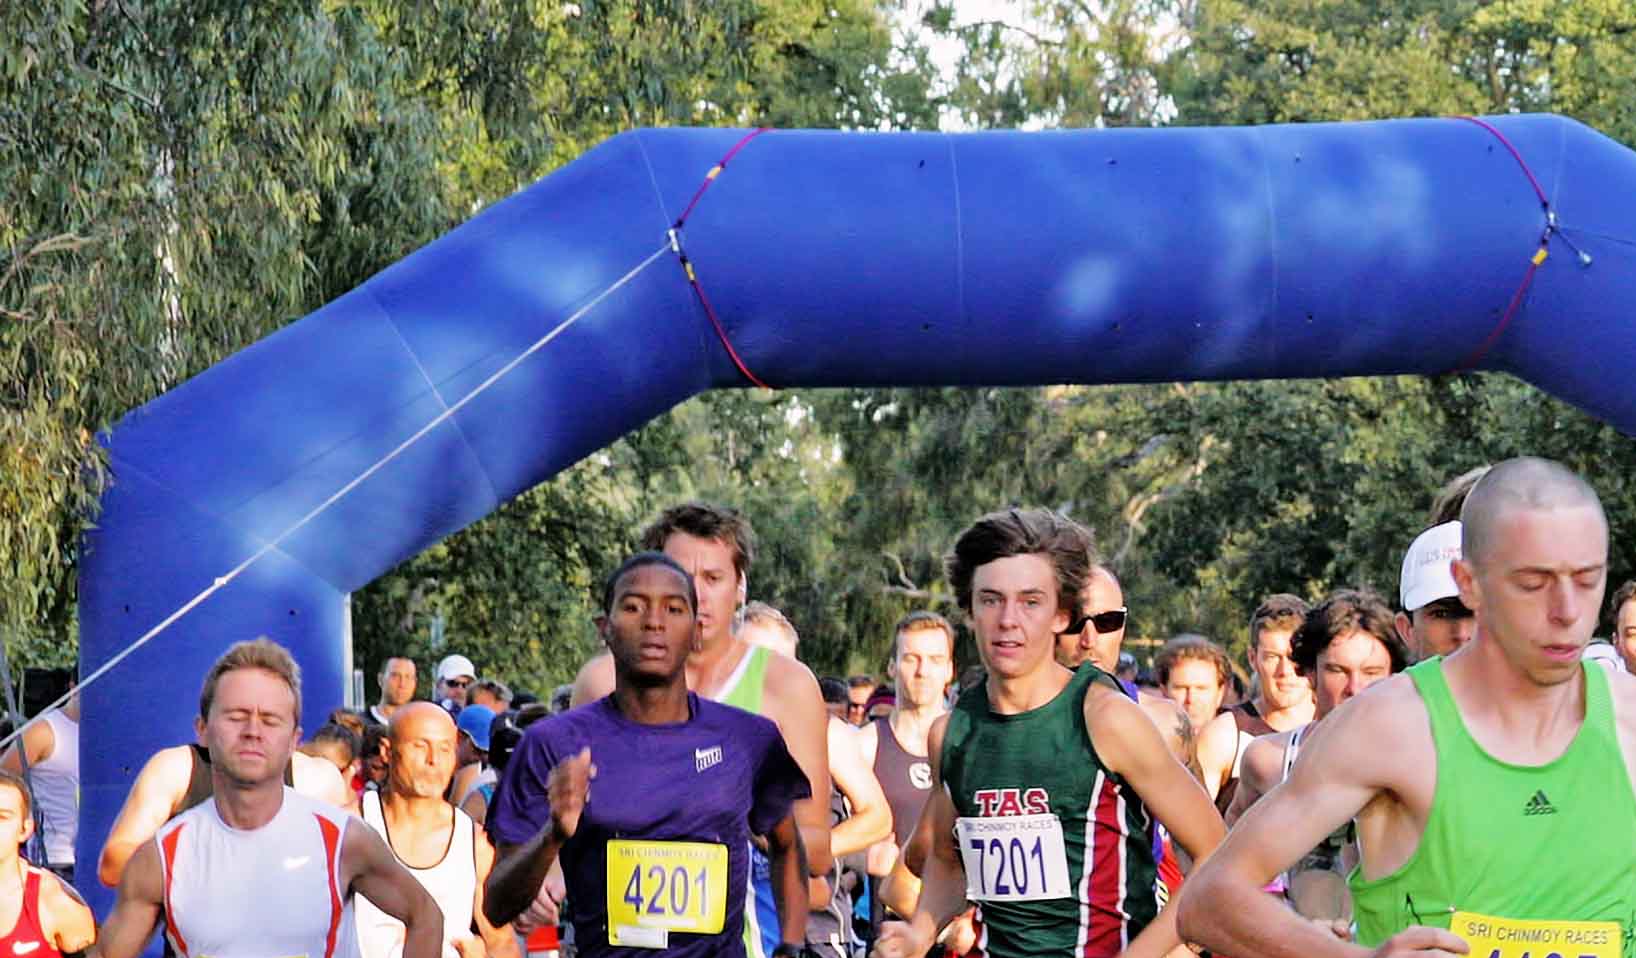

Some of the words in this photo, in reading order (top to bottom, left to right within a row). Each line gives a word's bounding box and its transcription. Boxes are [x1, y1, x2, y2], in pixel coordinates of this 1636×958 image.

[974, 788, 1050, 816] TAS
[970, 836, 1047, 895] 7201
[624, 863, 708, 917] 4201
[1467, 921, 1492, 938] SRI
[1496, 927, 1561, 944] CHINMOY
[1564, 930, 1609, 945] RACES
